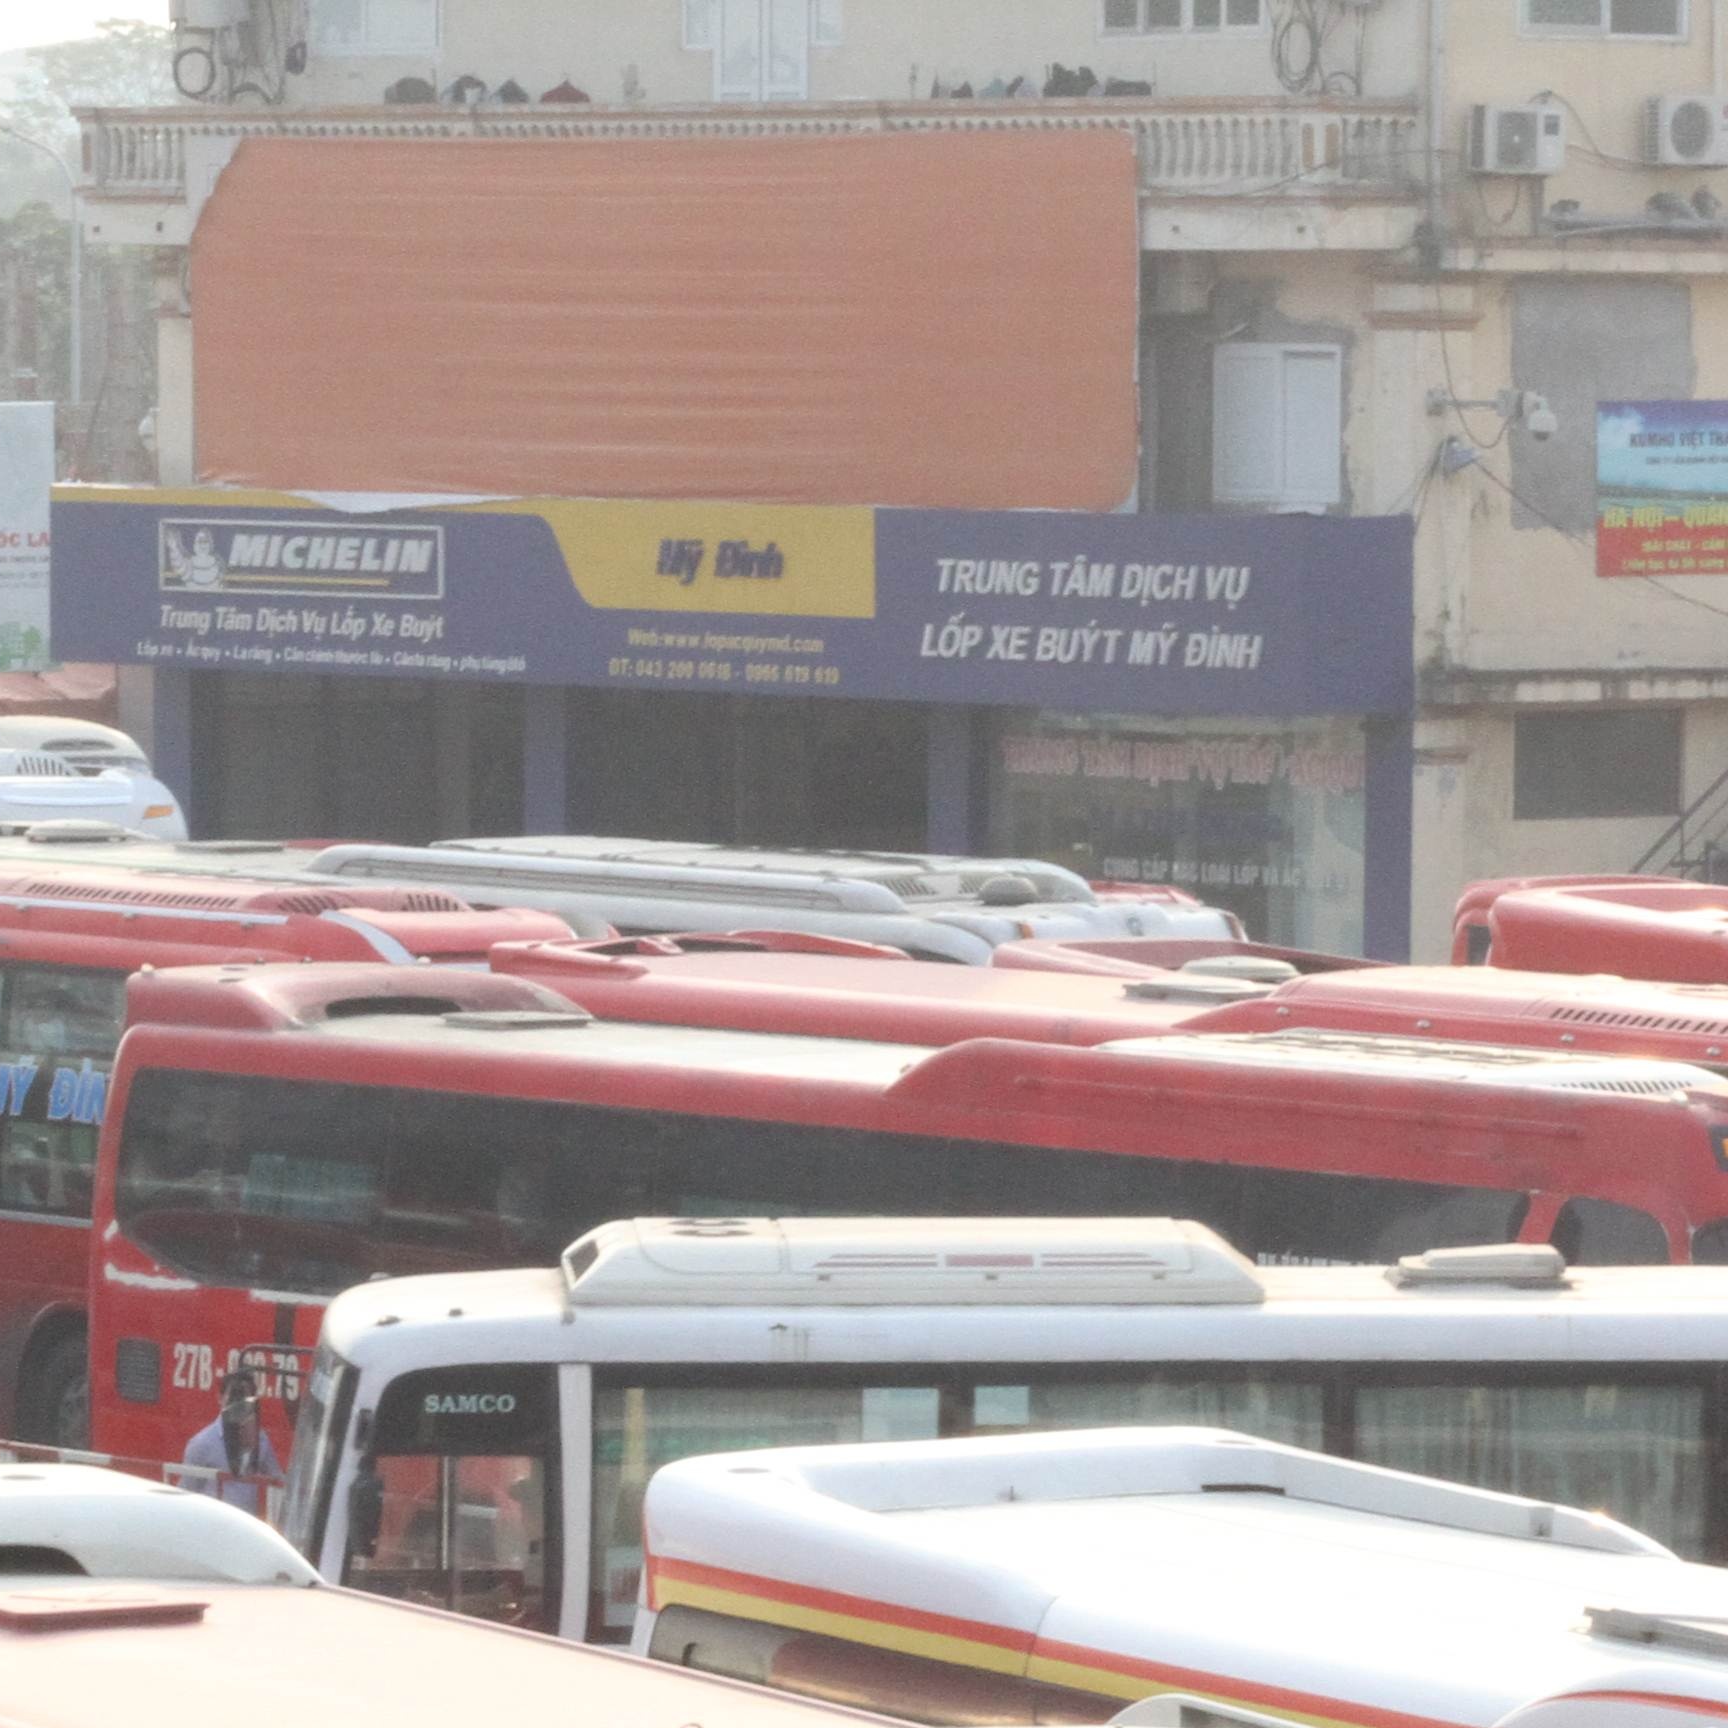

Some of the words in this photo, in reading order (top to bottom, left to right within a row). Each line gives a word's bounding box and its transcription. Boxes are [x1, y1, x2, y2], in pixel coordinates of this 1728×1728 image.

[228, 531, 435, 574] MICHELIN
[657, 537, 704, 587] Mỹ
[936, 558, 1040, 596] TRUNG
[1049, 554, 1116, 598] TÂM
[1119, 563, 1199, 607] DỊCH
[1205, 564, 1252, 610] VỤ
[159, 603, 213, 636] Trung
[215, 604, 253, 631] Tâm
[255, 607, 299, 639] Dịch
[301, 607, 328, 641] Vụ
[370, 609, 397, 638] Xe
[399, 612, 445, 644] Buýt
[920, 611, 984, 659] LỐP
[986, 623, 1032, 661] XE
[1034, 618, 1125, 665] BUÝT
[1125, 621, 1179, 666] MỸ
[1183, 624, 1265, 670] ĐÌNH
[172, 1342, 300, 1401] 27B-.79
[424, 1393, 516, 1414] SAMCO
